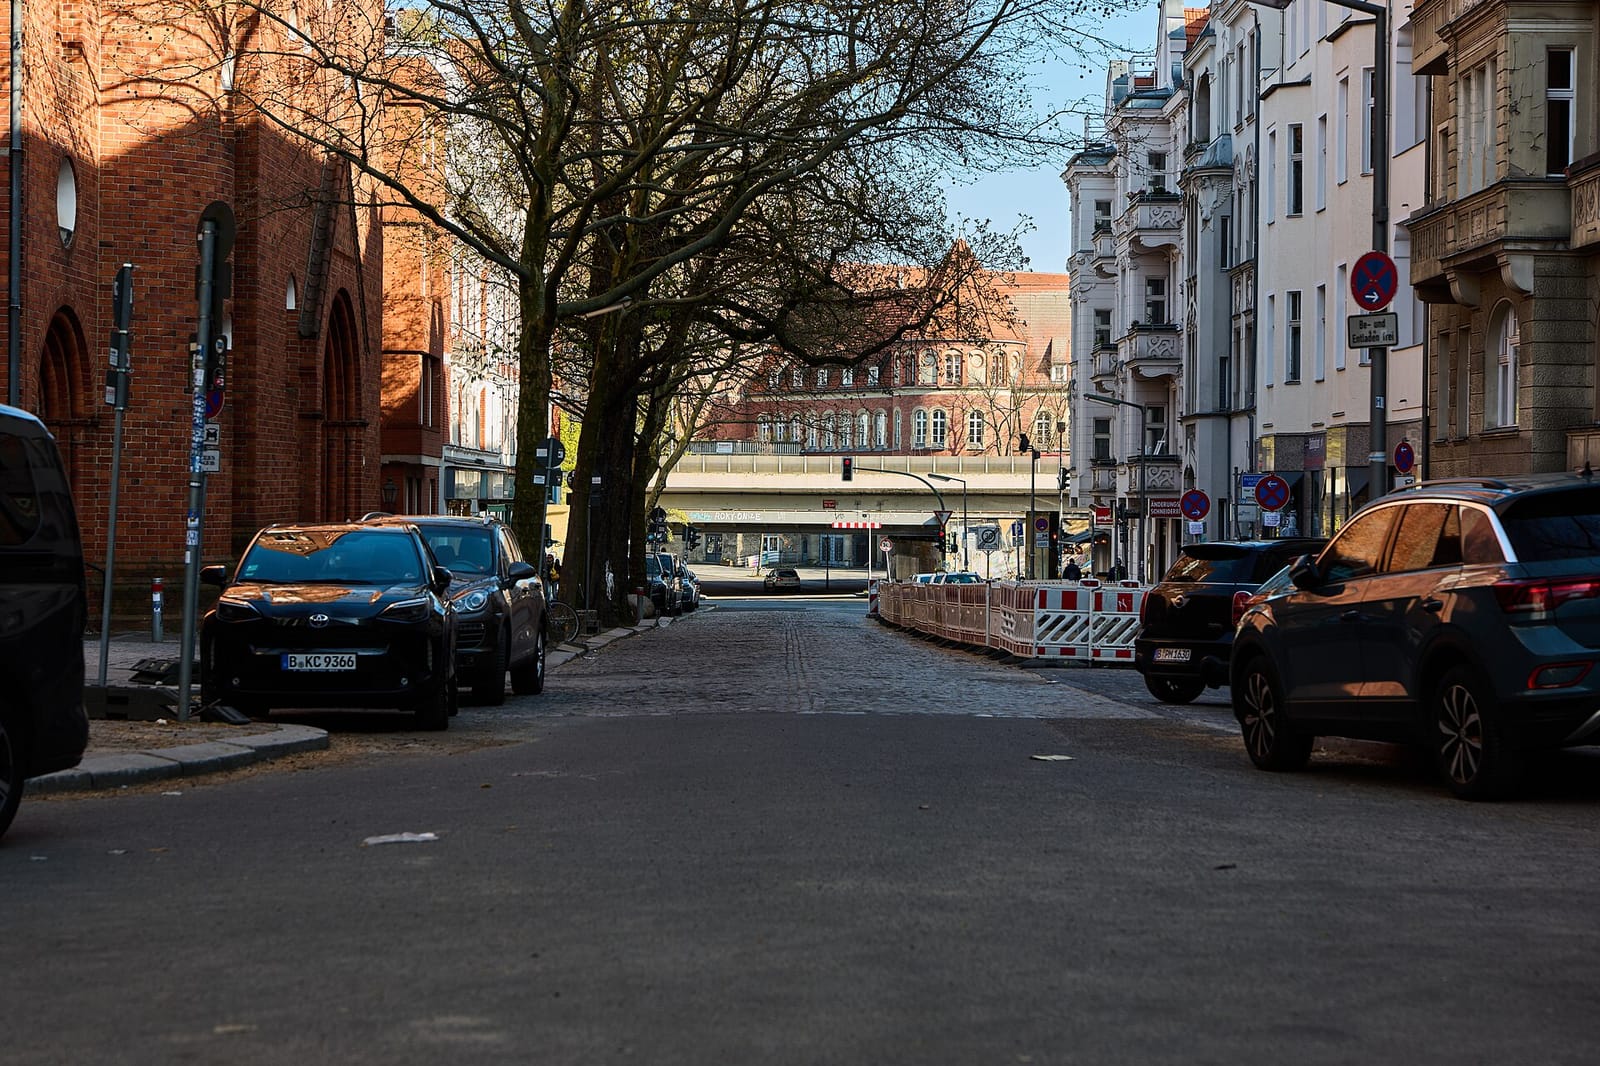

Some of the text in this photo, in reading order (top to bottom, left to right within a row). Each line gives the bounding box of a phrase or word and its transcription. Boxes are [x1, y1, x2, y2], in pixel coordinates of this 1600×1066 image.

[1373, 318, 1386, 328] und
[289, 655, 355, 668] B KC 9366
